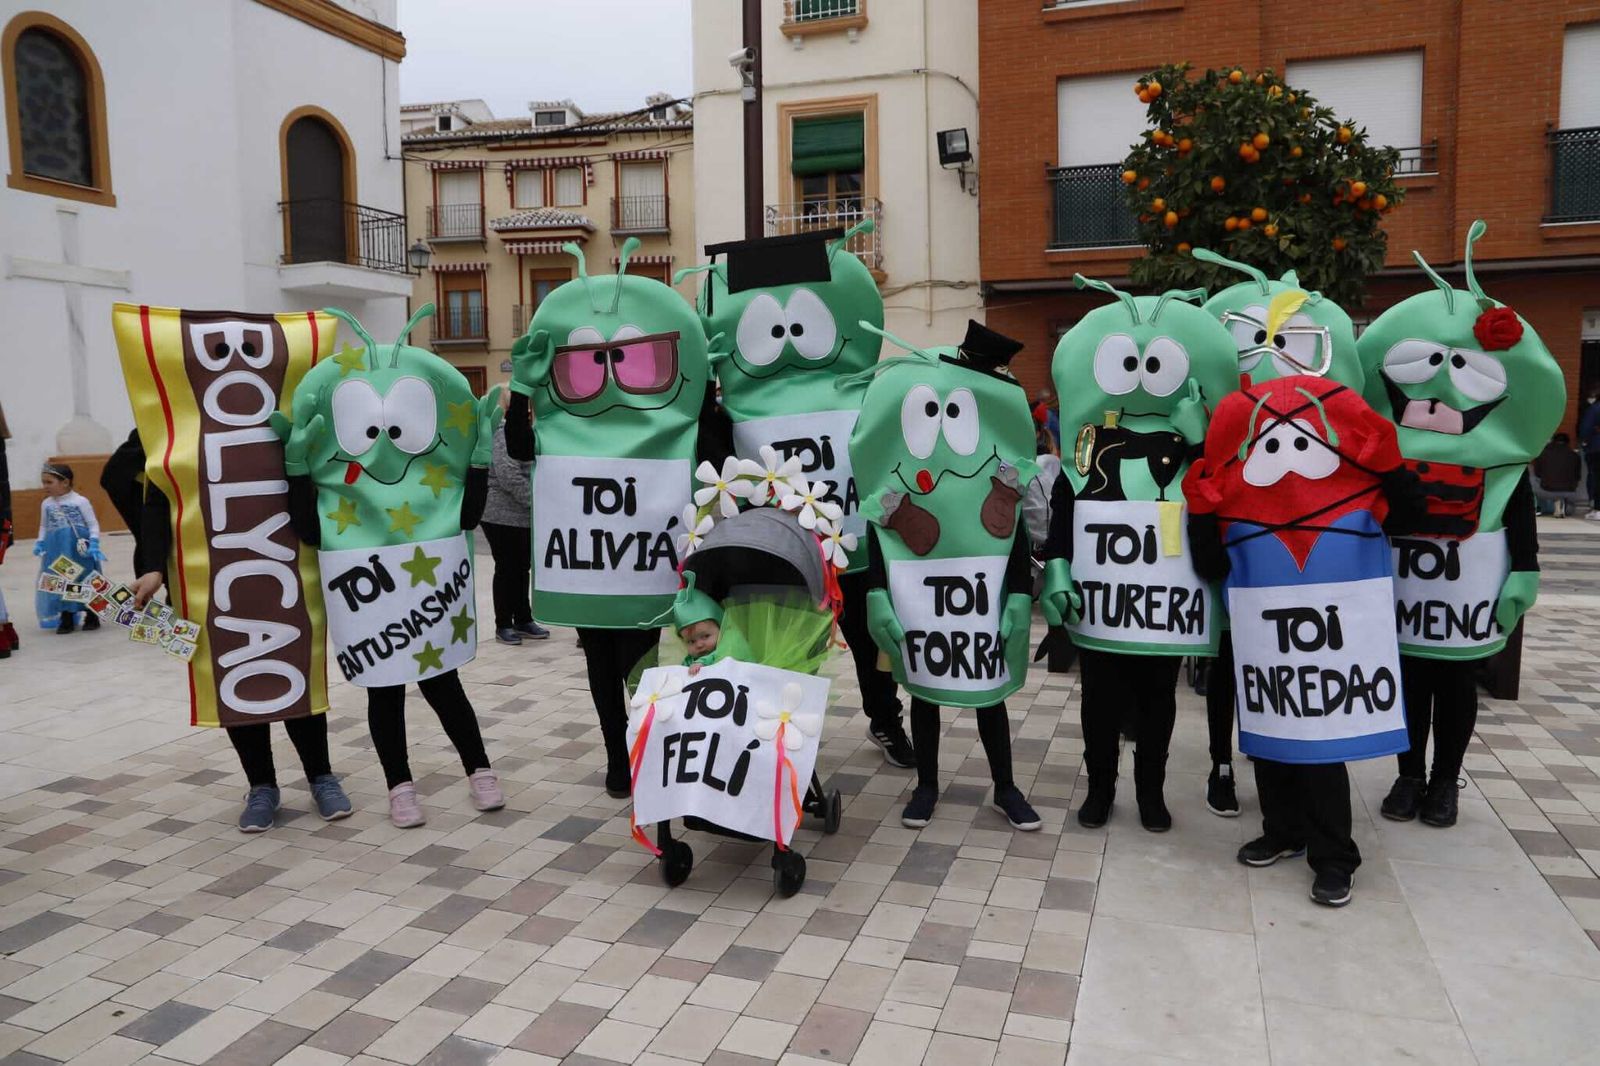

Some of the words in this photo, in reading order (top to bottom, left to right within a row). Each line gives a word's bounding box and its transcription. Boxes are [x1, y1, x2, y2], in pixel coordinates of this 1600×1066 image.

[189, 321, 306, 715] BOLLYCAO
[544, 516, 679, 571] ALIVIÁ
[336, 558, 471, 682] ENTUSIASMAO
[1241, 664, 1397, 718] ENREDAO
[662, 731, 761, 797] FELÍ
